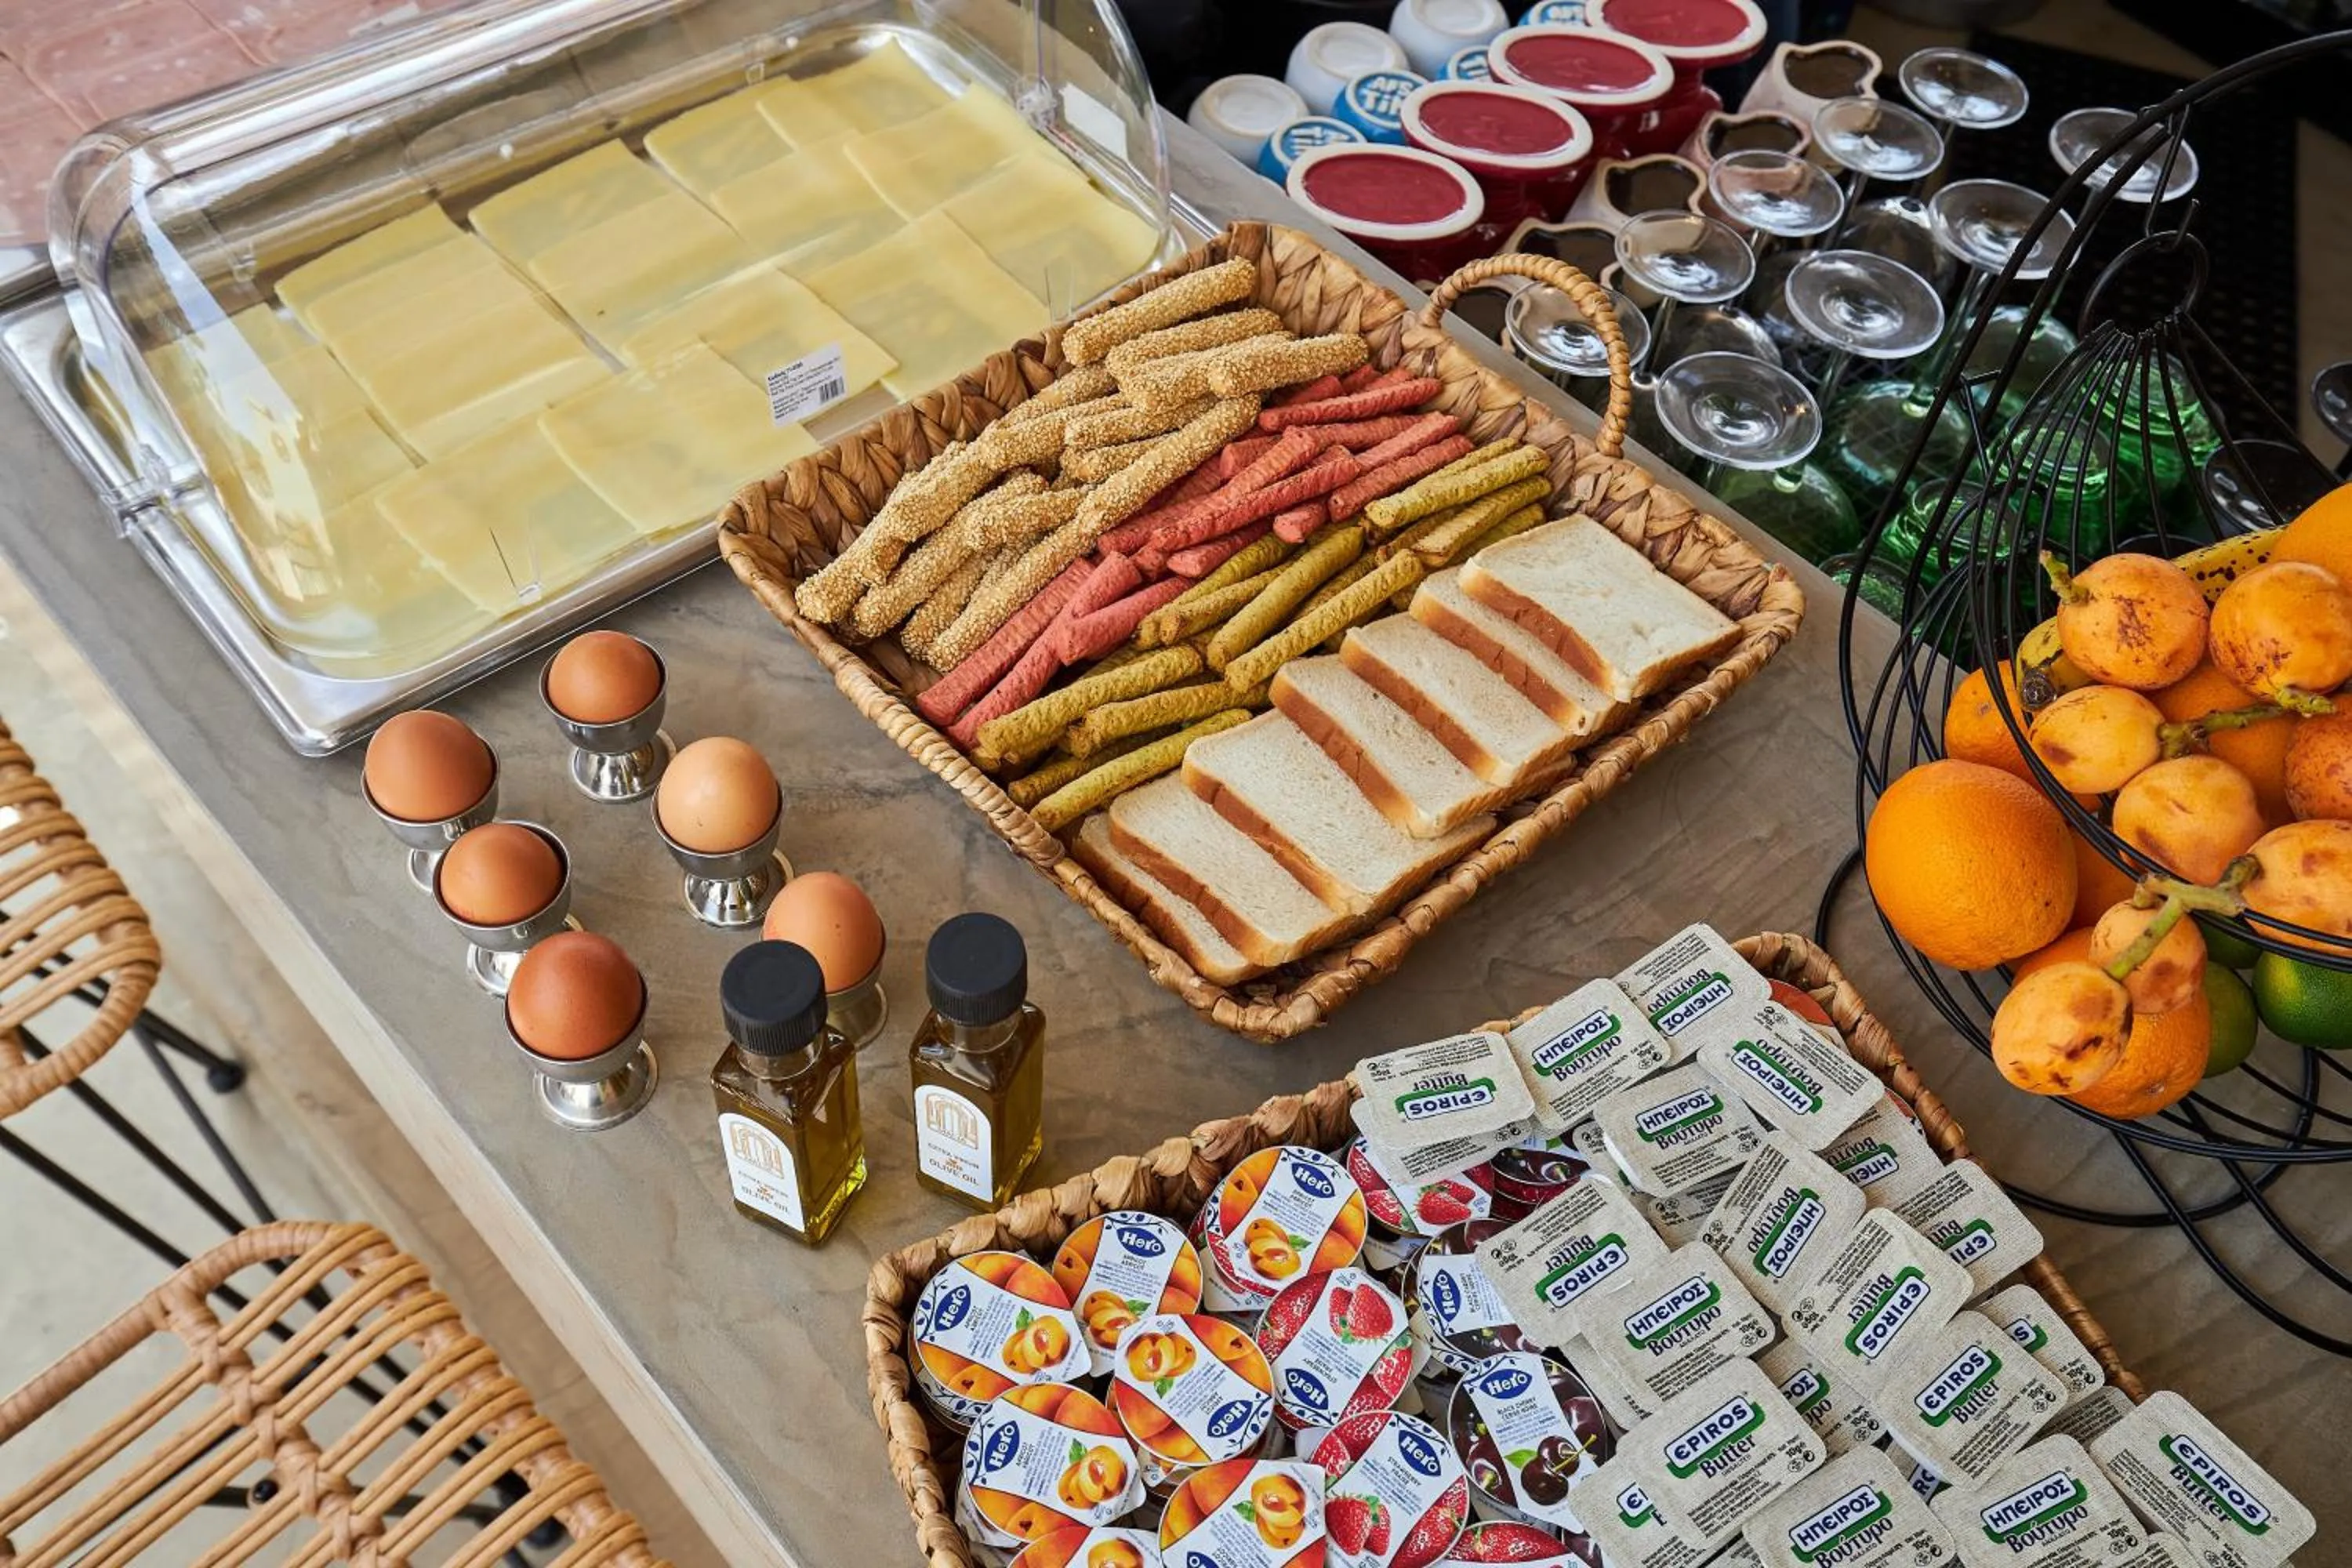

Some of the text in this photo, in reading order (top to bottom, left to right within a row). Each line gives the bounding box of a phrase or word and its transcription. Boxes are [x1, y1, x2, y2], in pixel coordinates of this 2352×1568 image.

[1408, 1089, 1486, 1115] EPIROS
[1411, 1073, 1468, 1094] Butter
[929, 1158, 960, 1177] OLIVE
[962, 1174, 978, 1186] OIL
[1826, 1135, 1878, 1171] Βούτυ
[1846, 1156, 1892, 1185] ΗΠΕΙ
[1294, 1166, 1334, 1195] Hero
[1121, 1231, 1163, 1253] Hero
[1542, 1232, 1596, 1276] Butter
[1927, 1218, 1964, 1250] But
[1948, 1232, 1989, 1265] EPI
[1436, 1272, 1456, 1315] Hero
[1550, 1247, 1621, 1302] EPIROS
[938, 1286, 967, 1328] Hero
[1845, 1272, 1895, 1327] Butter
[1860, 1279, 1922, 1352] EPIROS
[1284, 1370, 1326, 1405] Hero
[1486, 1370, 1528, 1396] Hero
[1922, 1350, 1986, 1411] EPIROS
[1950, 1375, 2002, 1425] Butter
[1210, 1399, 1247, 1439] Hero
[1671, 1402, 1748, 1462] EPIROS
[988, 1422, 1016, 1468] Hero
[1399, 1435, 1441, 1473] Hero
[1699, 1432, 1758, 1479] Butter
[2169, 1462, 2233, 1526] Butter
[2176, 1441, 2261, 1520] EPIROS
